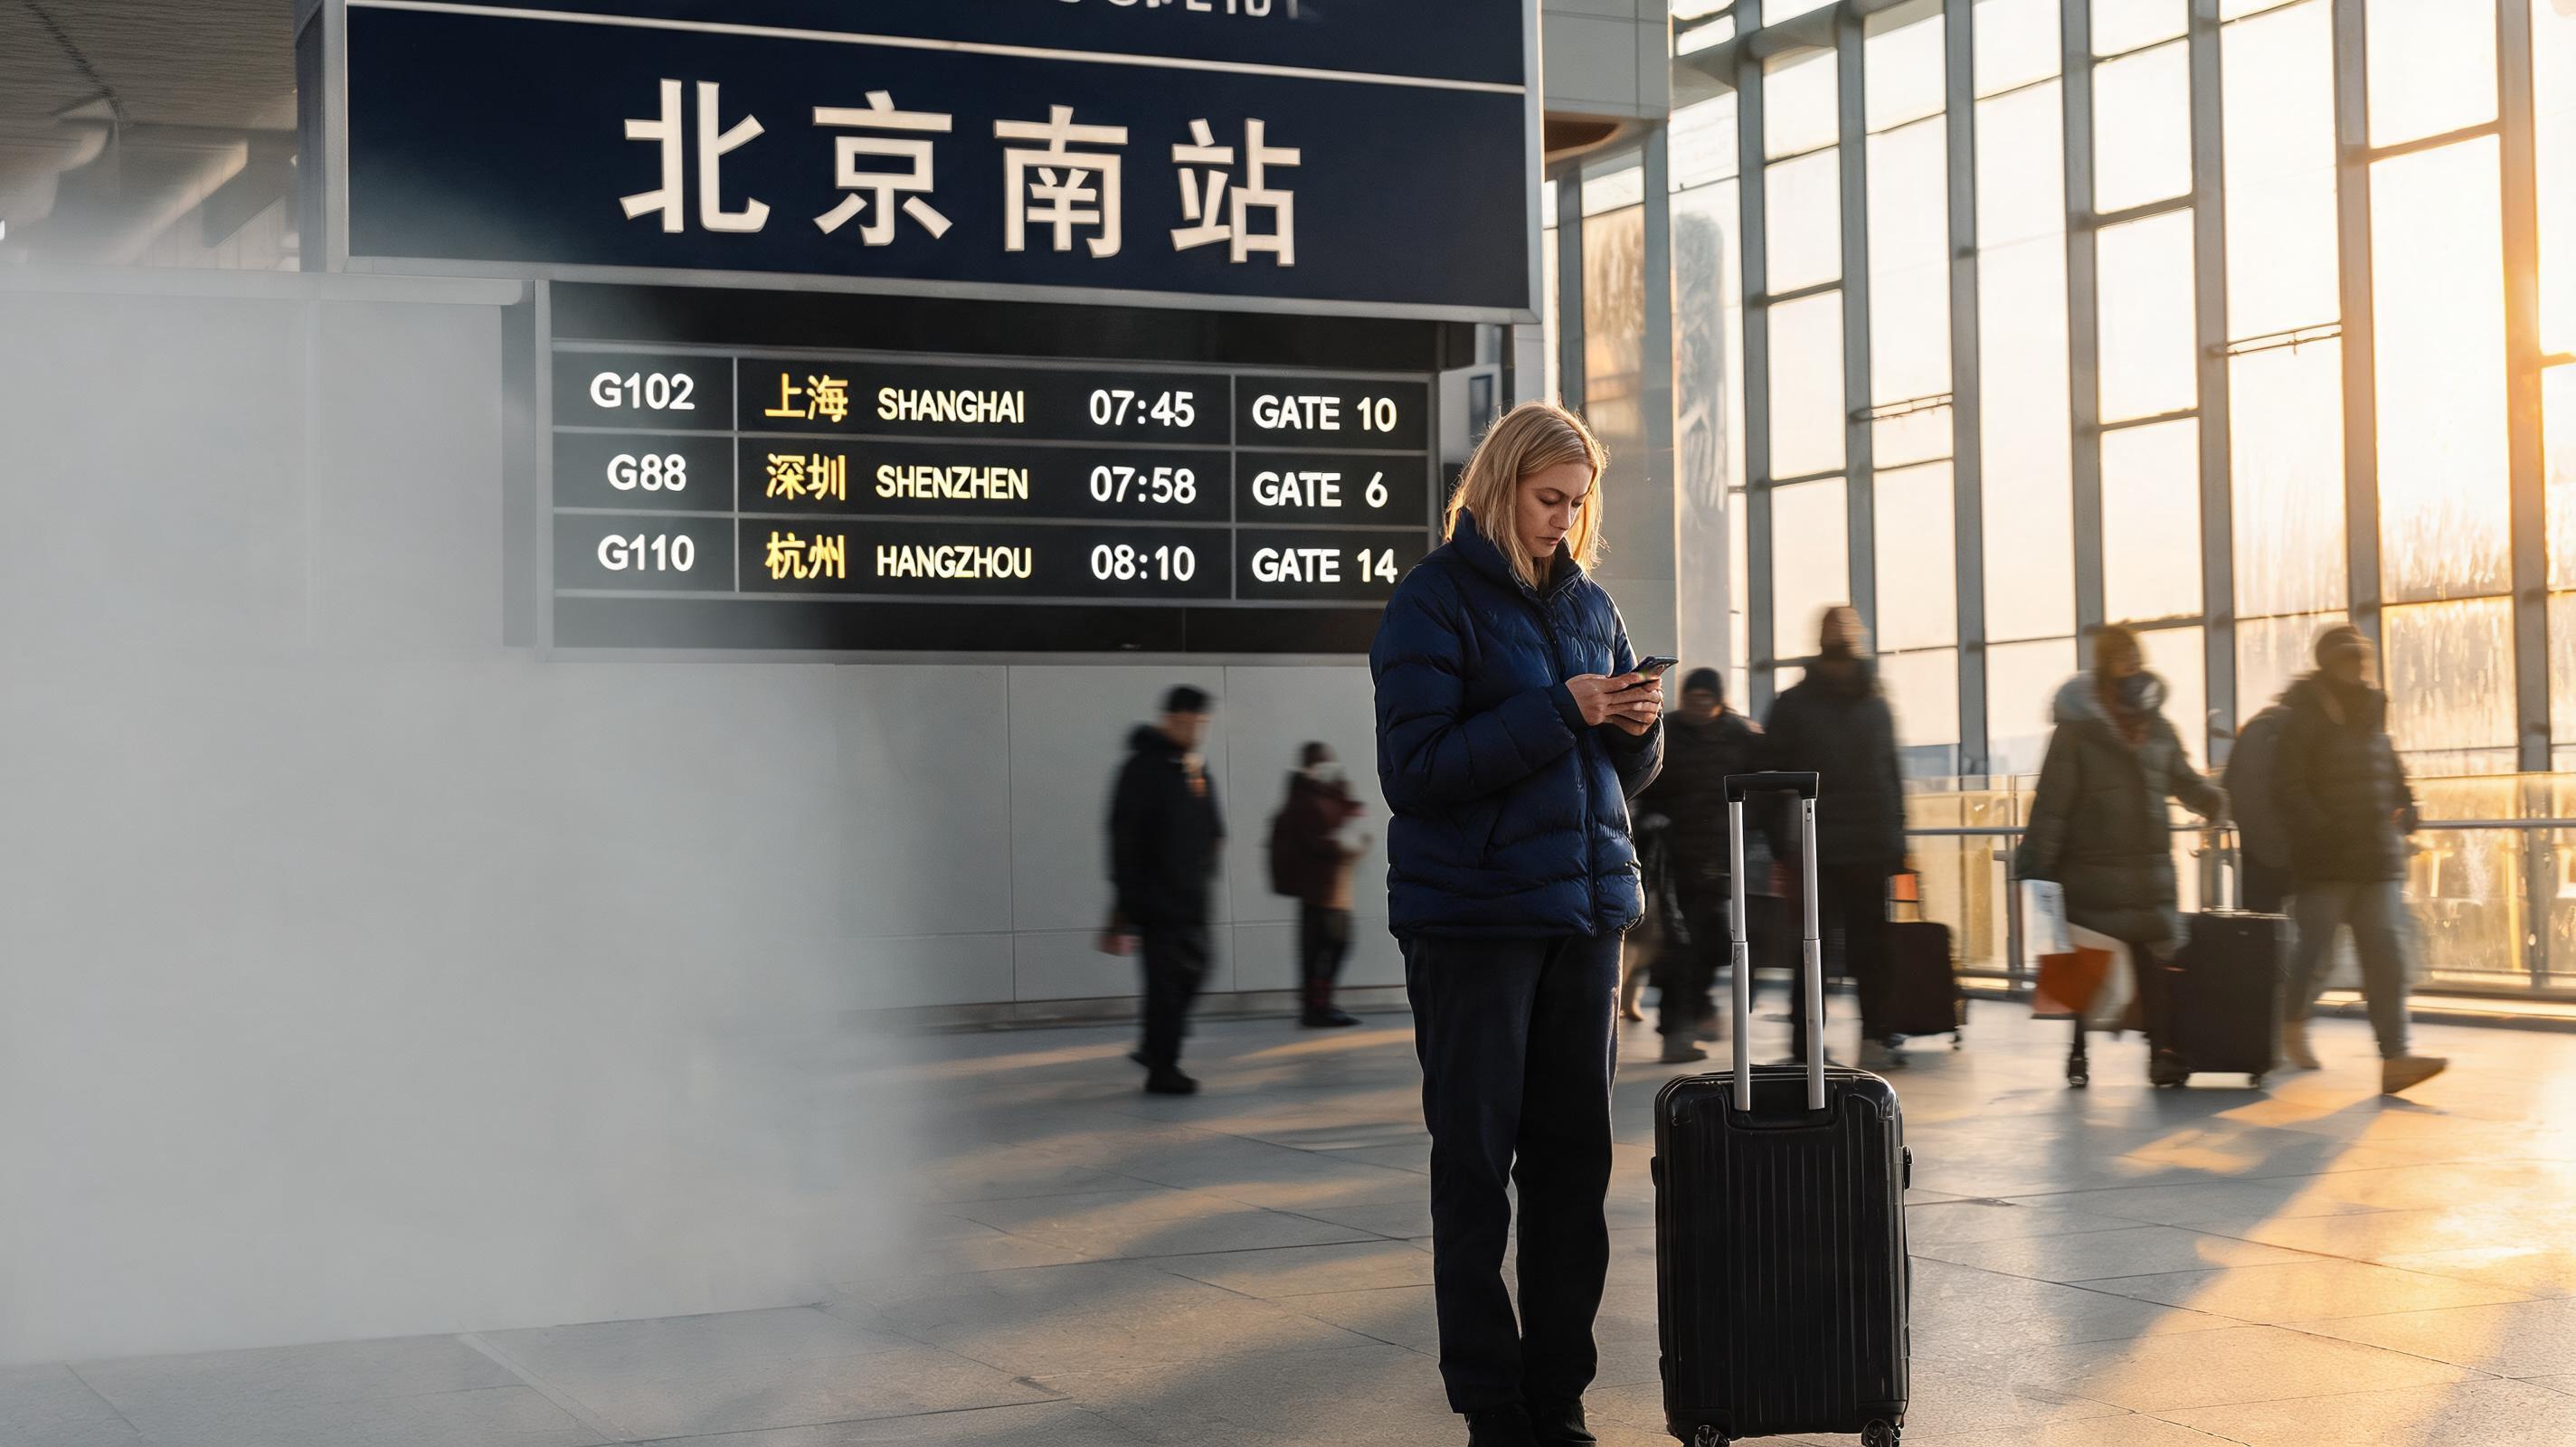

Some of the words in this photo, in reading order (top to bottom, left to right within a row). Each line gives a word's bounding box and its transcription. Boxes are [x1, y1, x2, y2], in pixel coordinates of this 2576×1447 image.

[620, 78, 1302, 266] 北京南站
[590, 372, 696, 411] G102
[765, 373, 848, 423] 上海
[876, 387, 1025, 423] SHANGHAI
[1089, 389, 1195, 428] 07:45
[1253, 395, 1340, 430] GATE
[1358, 397, 1397, 433] 10
[607, 454, 687, 492] G88
[766, 452, 846, 501] 深圳
[876, 464, 1028, 500] SHENZHEN
[1091, 466, 1197, 505] 07:58
[1253, 471, 1342, 507] GATE
[1366, 472, 1388, 508] 6
[597, 534, 696, 572] G110
[765, 531, 846, 580] 杭州
[876, 544, 1032, 579] HANGZHOU
[1091, 544, 1196, 582] 08:10
[1252, 547, 1341, 583] GATE
[1357, 548, 1398, 584] 14
